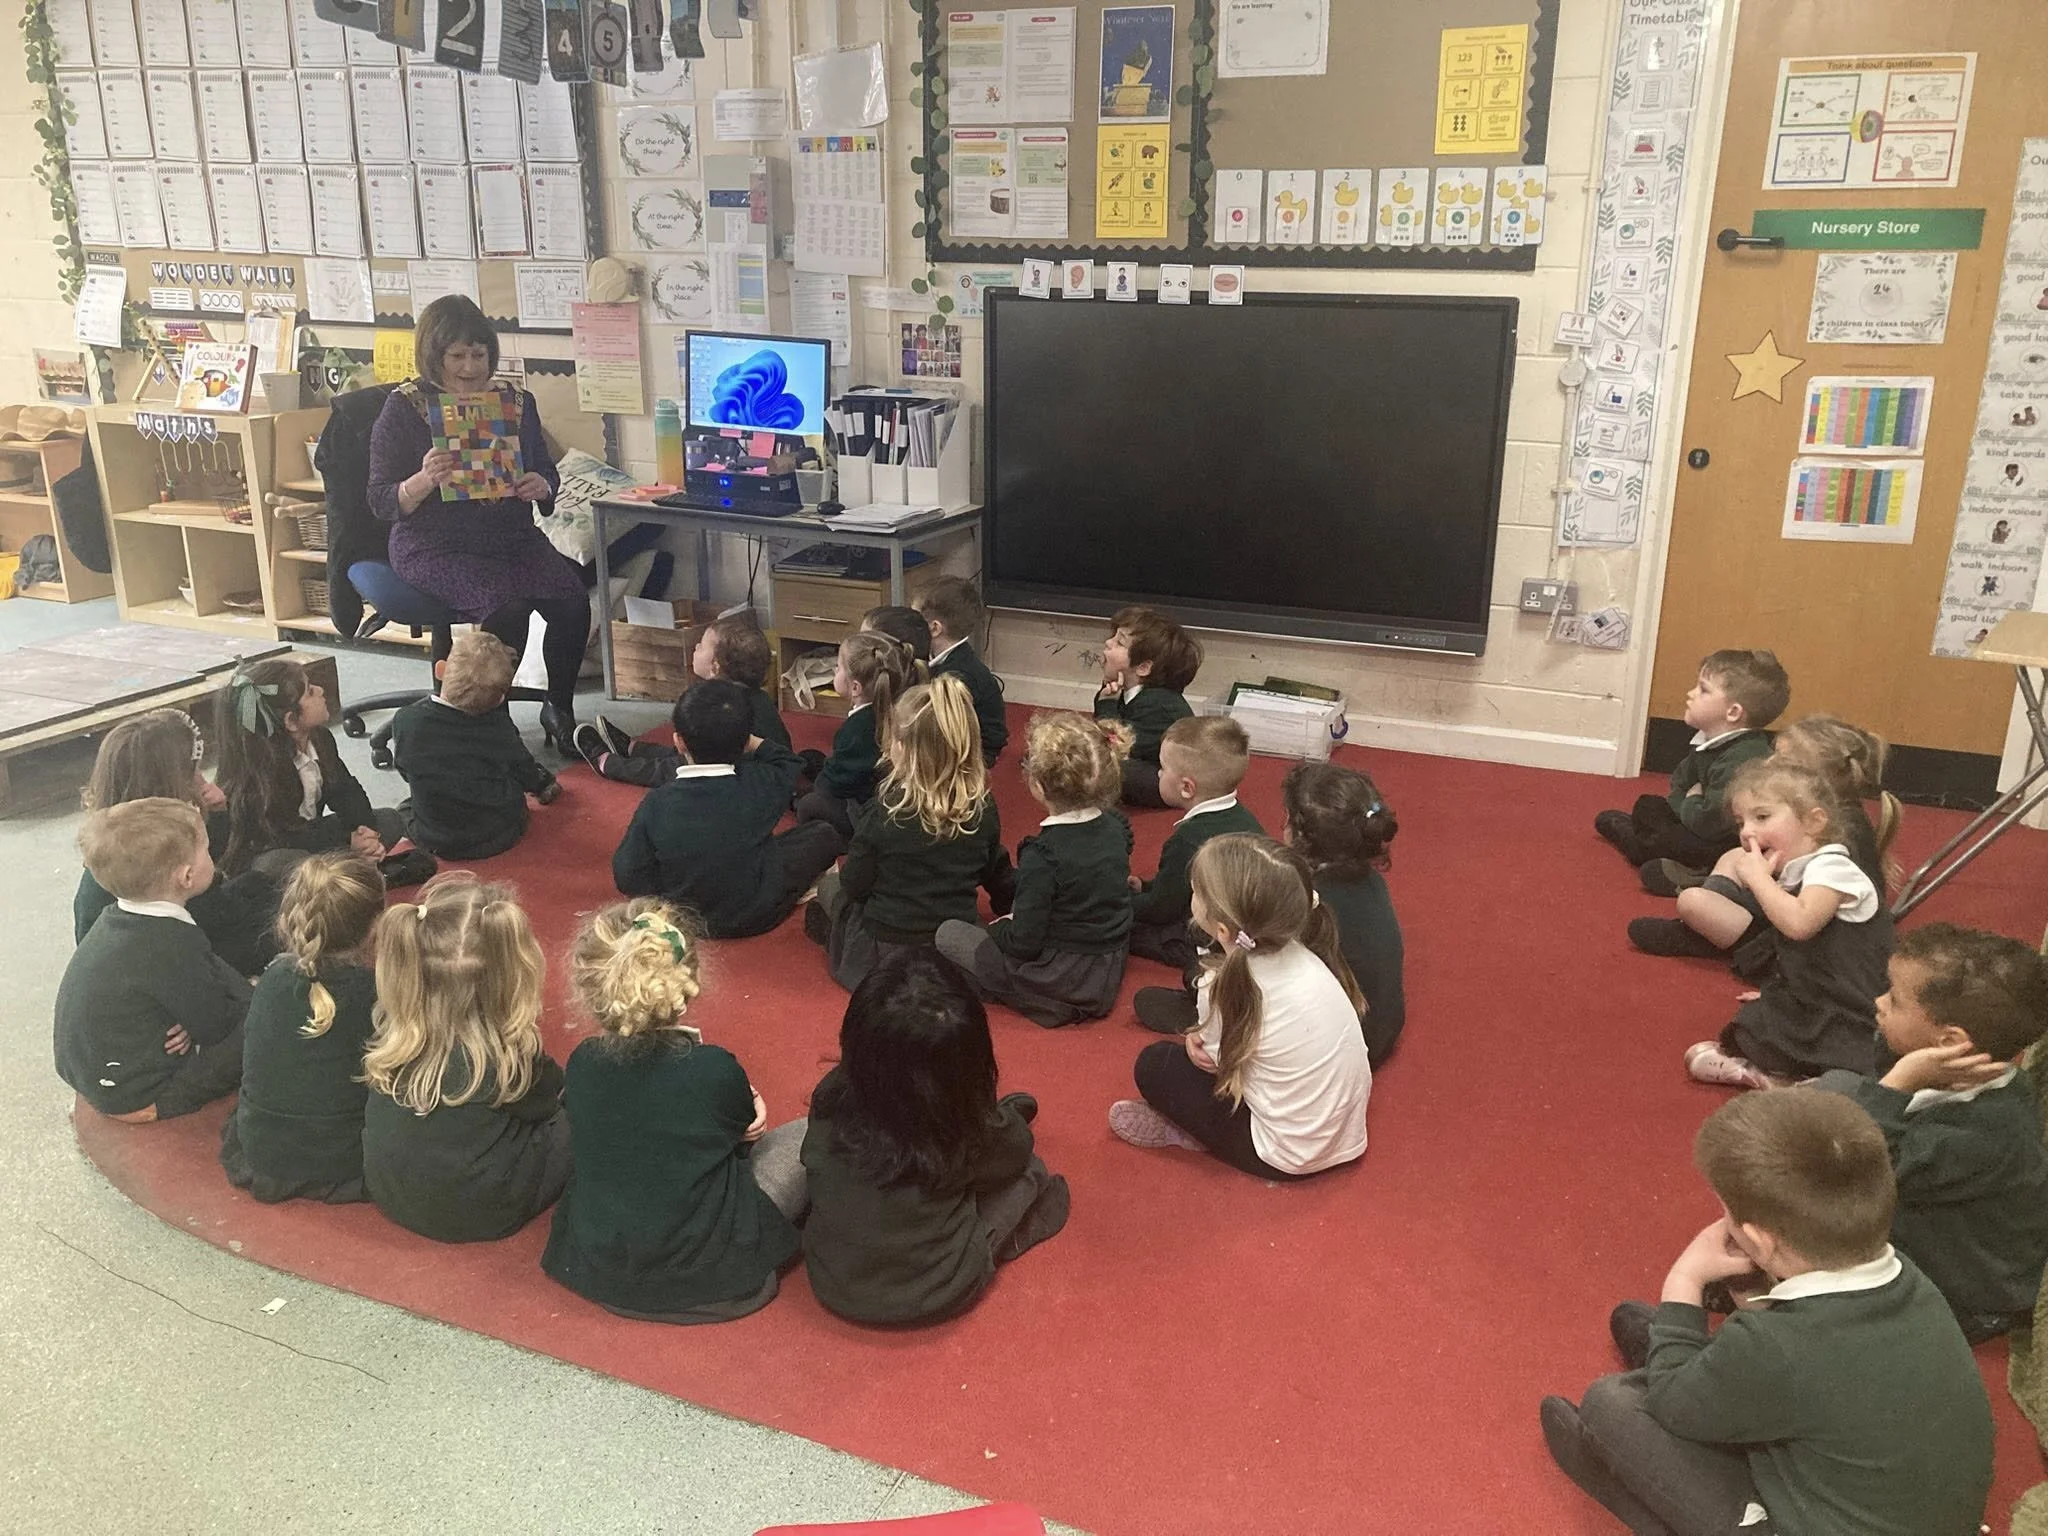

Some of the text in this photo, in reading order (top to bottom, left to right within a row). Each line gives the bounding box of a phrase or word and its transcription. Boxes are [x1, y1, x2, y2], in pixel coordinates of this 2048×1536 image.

[557, 29, 573, 56] 4
[603, 30, 614, 52] 5
[1458, 53, 1473, 63] 123
[1886, 60, 1933, 69] questions
[657, 138, 675, 148] right
[1236, 172, 1242, 181] 0
[1290, 173, 1295, 181] 1
[1344, 172, 1350, 180] 2
[1400, 171, 1407, 179] 3
[1811, 221, 1920, 237] Nursery Store
[152, 263, 292, 282] WONDER WALL
[2017, 272, 2045, 284] good
[1873, 283, 1891, 295] 24
[2004, 333, 2031, 344] good
[2000, 390, 2023, 399] take
[137, 414, 212, 434] Maths
[1986, 448, 2046, 458] kind words
[562, 474, 611, 498] FALL
[1968, 504, 2042, 517] indoor voices
[1960, 560, 2028, 573] walk indoors
[1950, 613, 1977, 623] good
